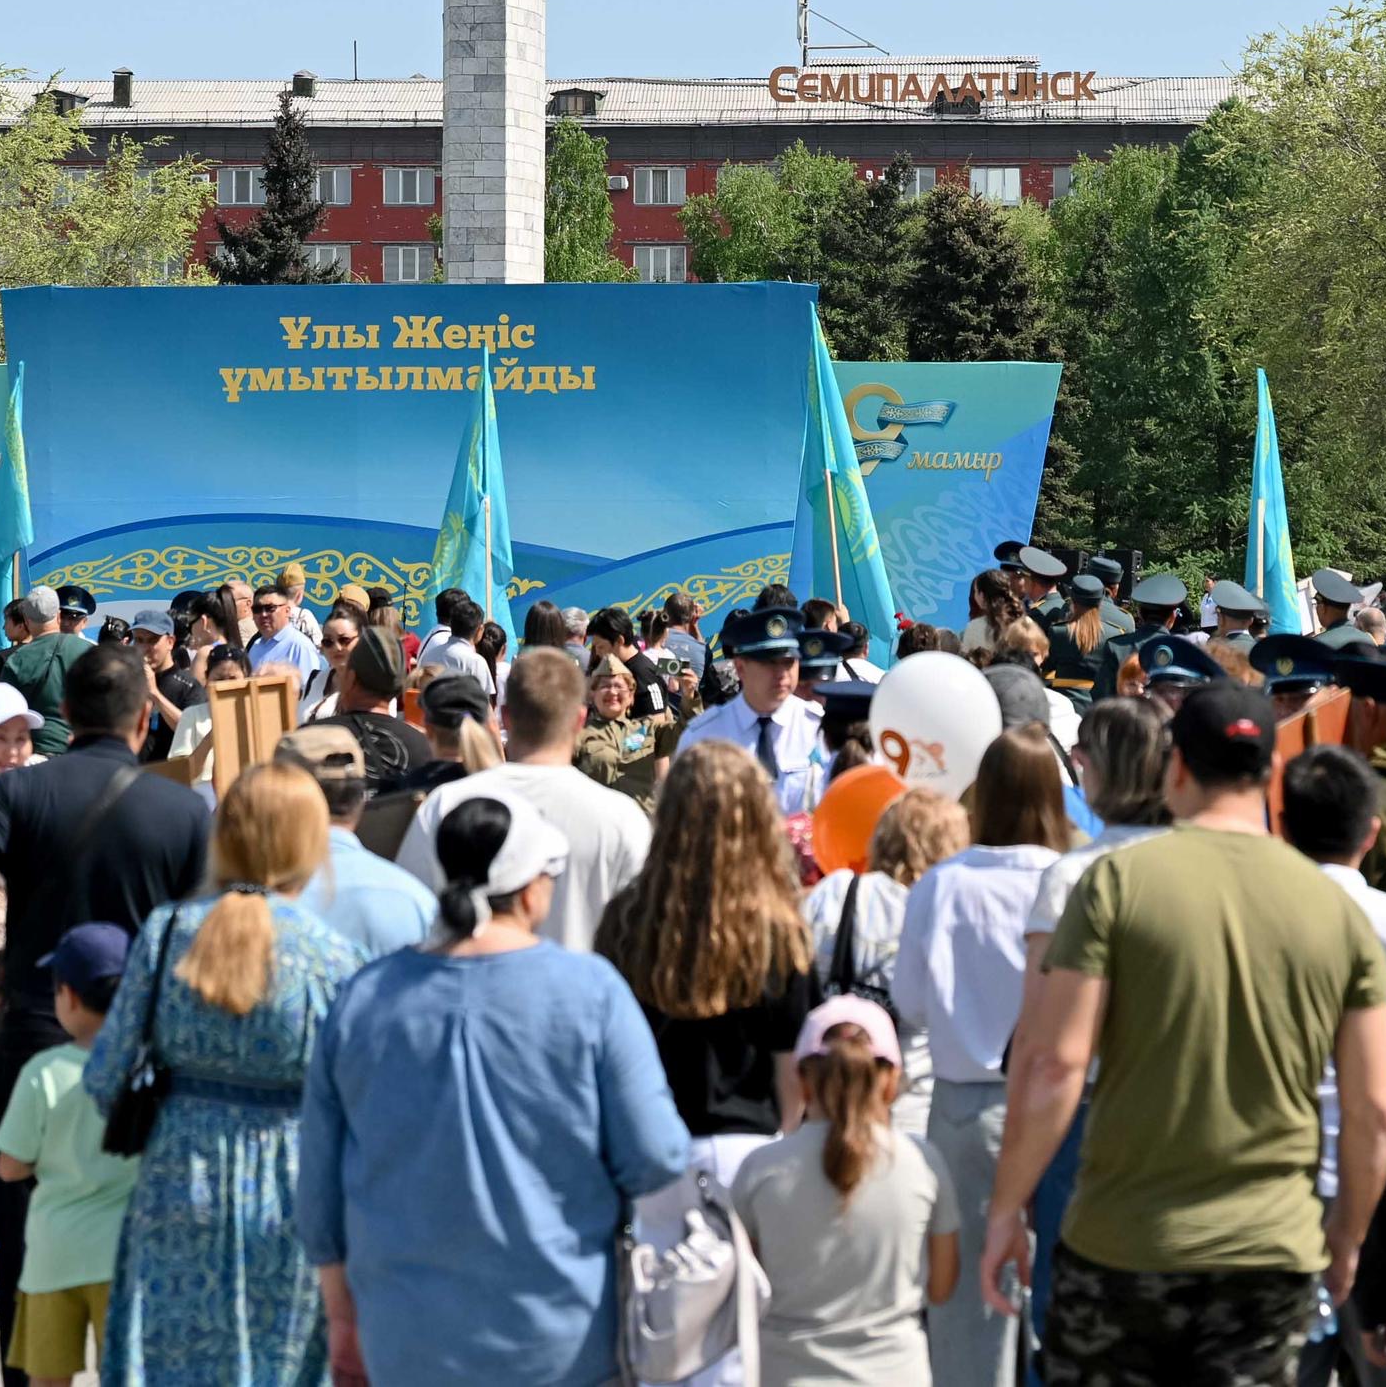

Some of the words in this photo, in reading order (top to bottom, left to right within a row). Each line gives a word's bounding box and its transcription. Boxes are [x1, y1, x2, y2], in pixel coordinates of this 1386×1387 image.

[279, 316, 381, 350] Ұлы
[392, 314, 536, 354] Жеңіс
[907, 451, 1003, 482] мамыр
